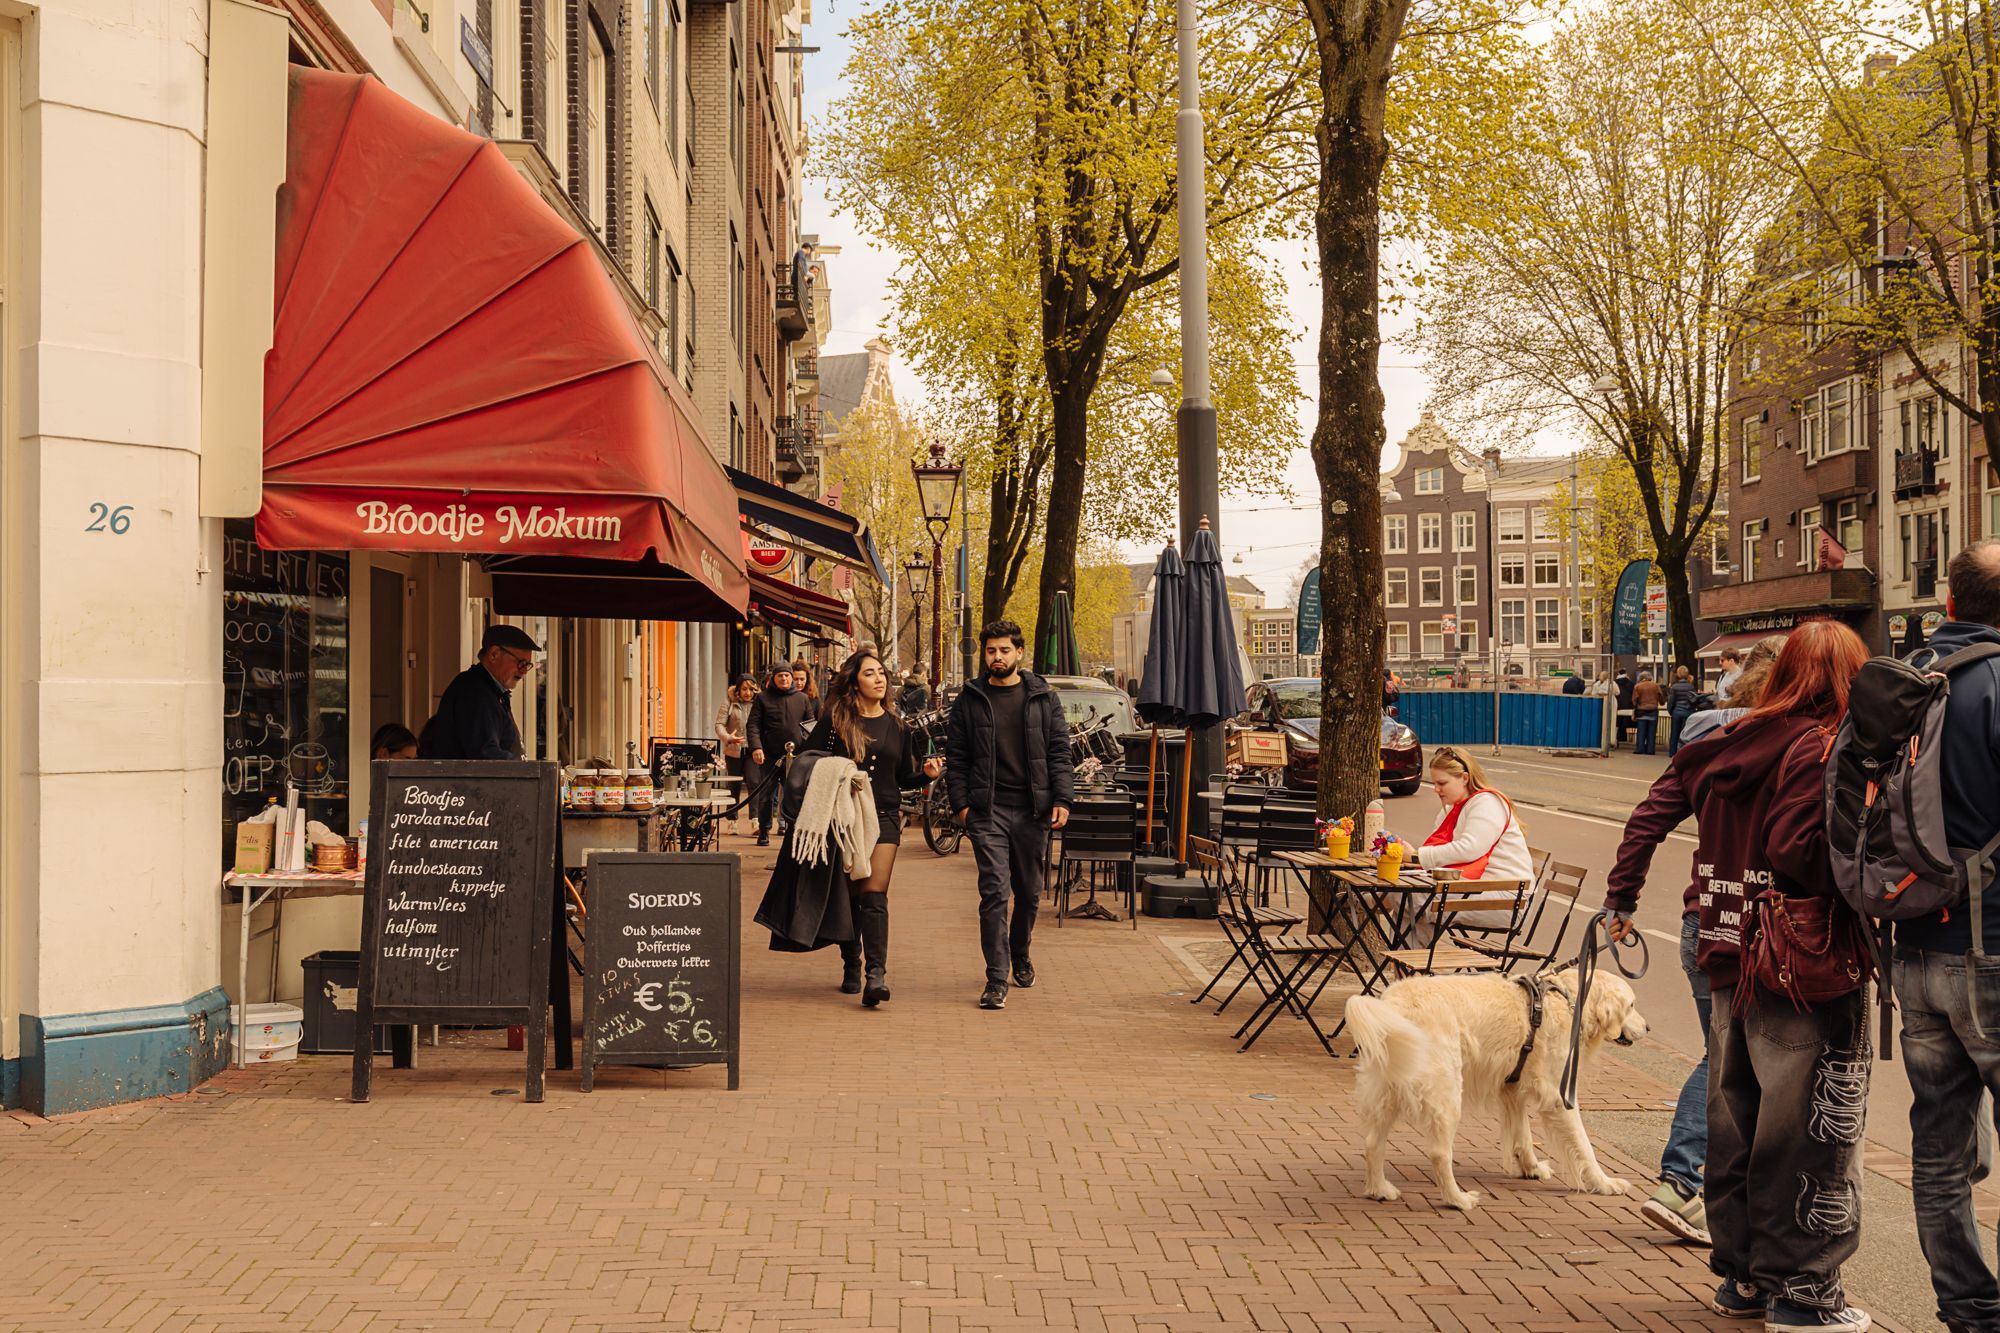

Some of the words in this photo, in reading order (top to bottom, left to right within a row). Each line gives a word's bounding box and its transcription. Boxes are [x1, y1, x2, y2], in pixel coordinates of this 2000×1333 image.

[84, 502, 134, 535] 26
[356, 500, 485, 543] Broodje
[495, 505, 622, 544] Mokum
[222, 754, 275, 795] OEP
[404, 785, 466, 811] Broodjes
[389, 832, 422, 850] filet
[429, 838, 499, 850] american
[387, 858, 483, 876] hindoestaans
[449, 879, 507, 899] kippetje
[628, 891, 702, 911] SJOERD'S
[384, 918, 438, 938] halfom
[622, 925, 648, 936] Oud
[650, 925, 702, 938] hollandse
[636, 941, 692, 954] Poffertjes
[616, 957, 678, 969] Ouderwets
[681, 956, 711, 968] lekker
